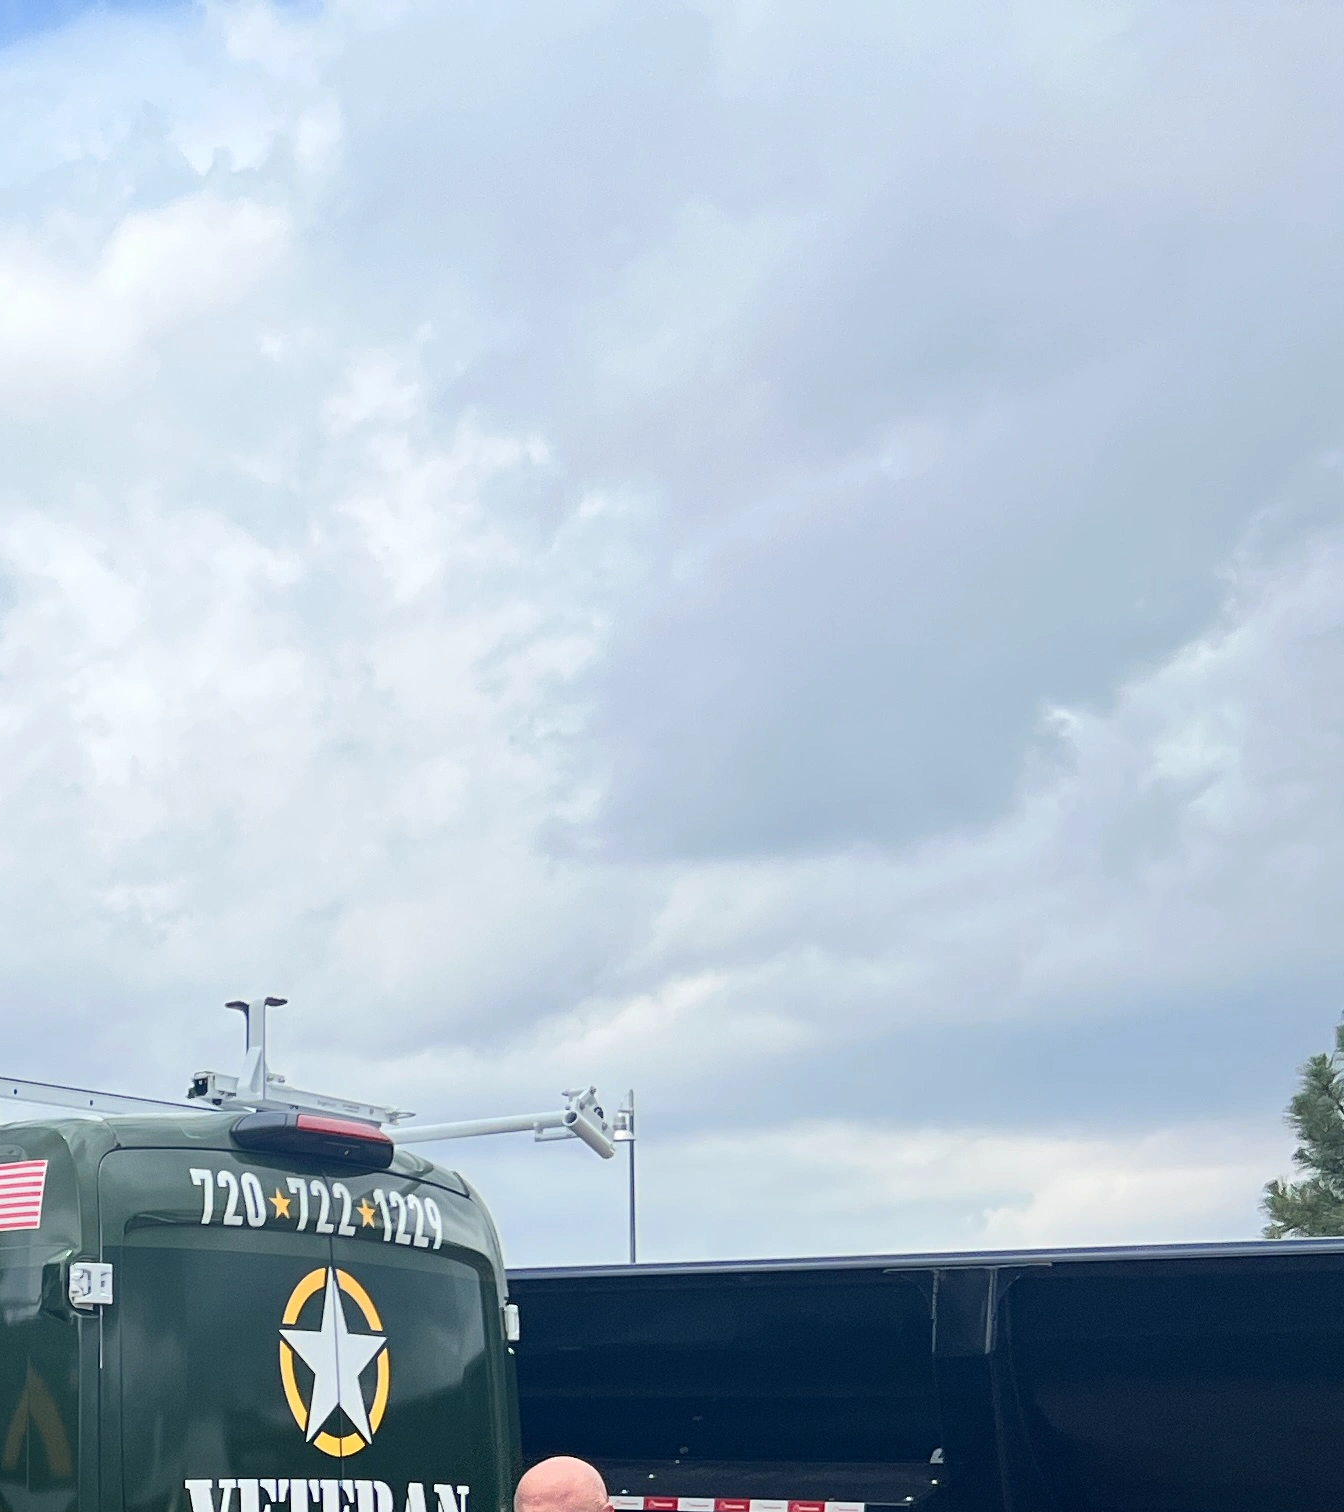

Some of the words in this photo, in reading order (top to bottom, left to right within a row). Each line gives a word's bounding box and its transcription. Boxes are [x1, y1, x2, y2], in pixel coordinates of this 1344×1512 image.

[189, 1168, 267, 1227] 720
[286, 1177, 356, 1237] 722
[373, 1188, 443, 1250] 1229
